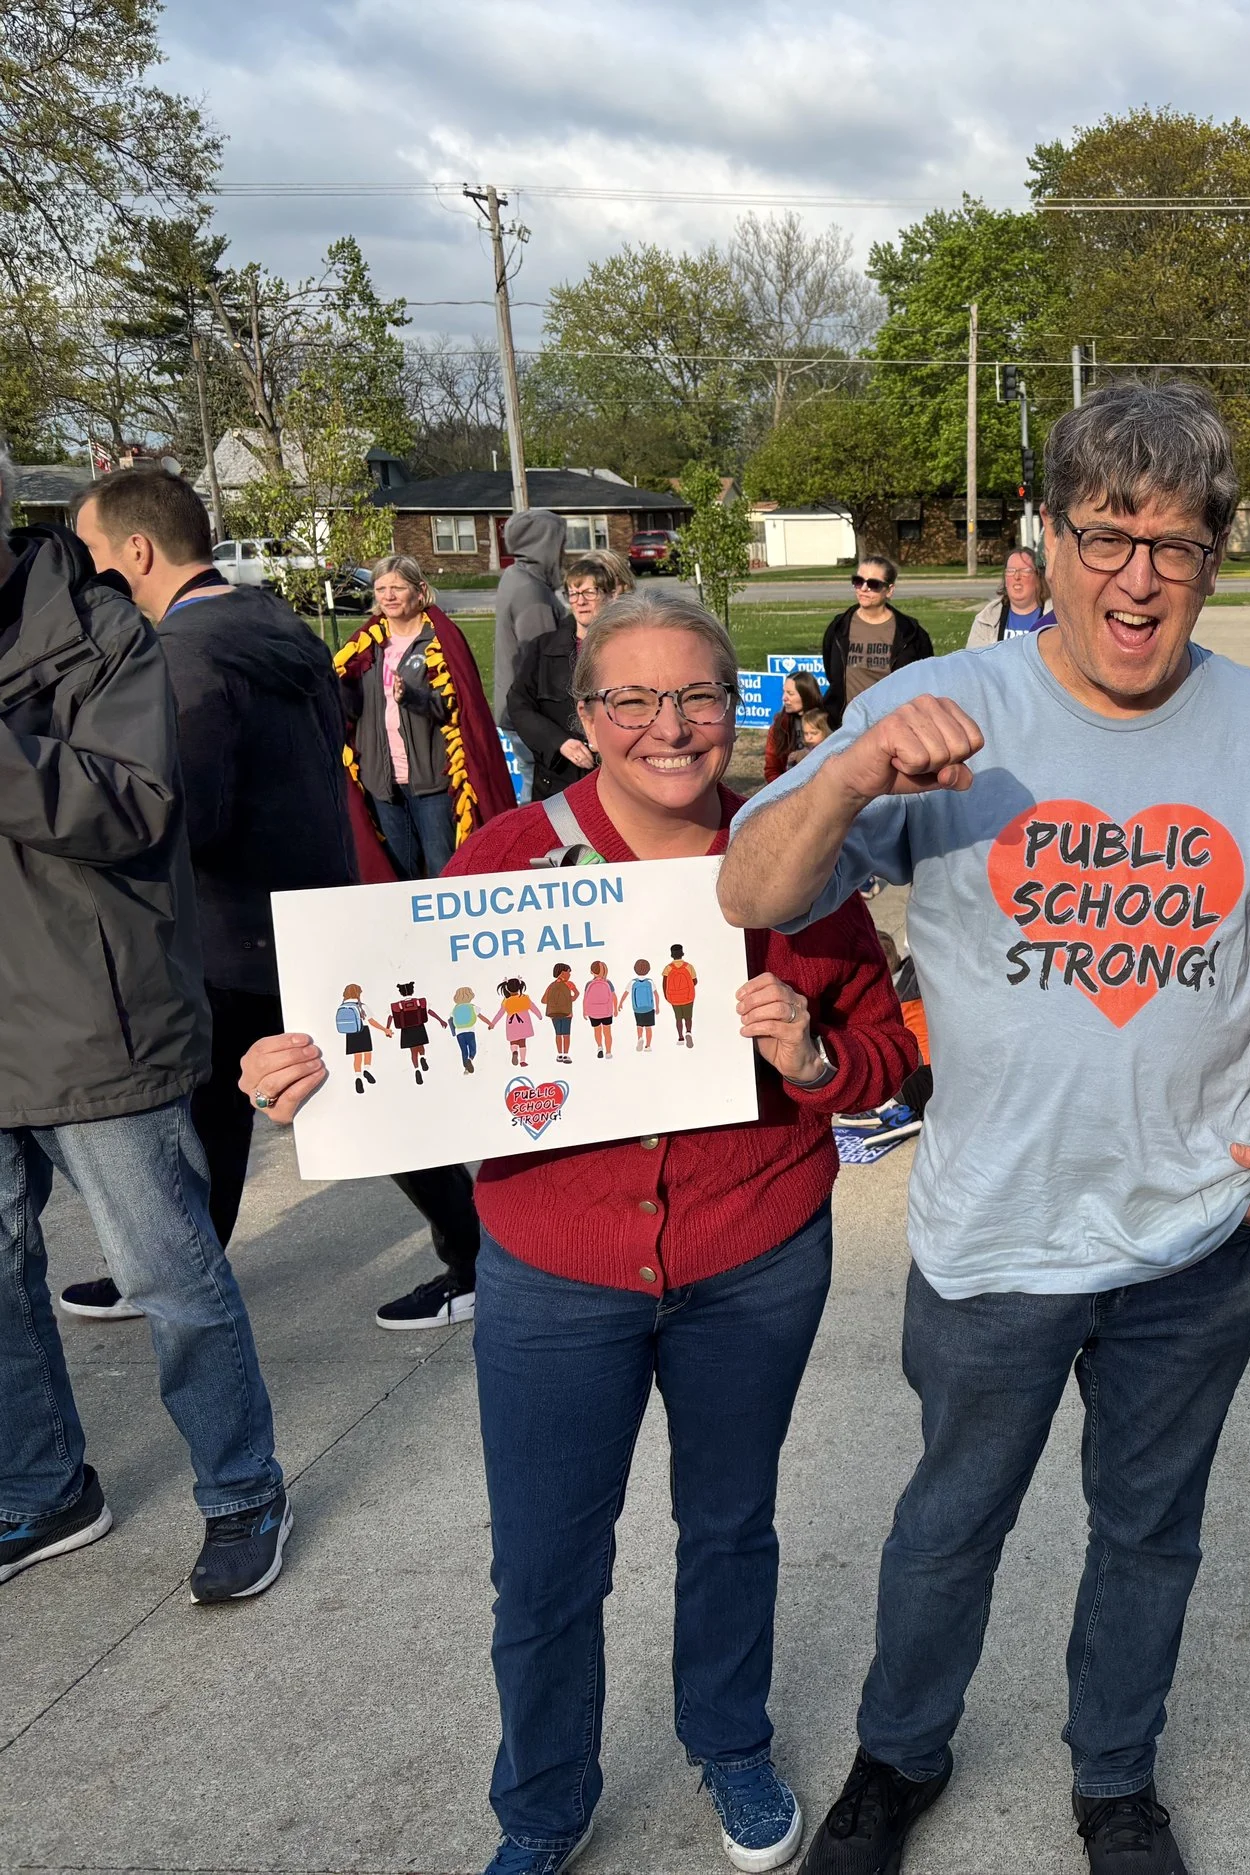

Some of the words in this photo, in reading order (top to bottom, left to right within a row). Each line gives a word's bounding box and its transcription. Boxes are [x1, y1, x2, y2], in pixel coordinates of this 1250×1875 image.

[774, 659, 781, 672] I
[1025, 821, 1211, 870] PUBLIC
[411, 876, 624, 923] EDUCATION
[1013, 881, 1221, 929] SCHOOL
[450, 928, 525, 962] FOR
[536, 921, 605, 953] ALL
[1006, 940, 1221, 993] STRONG!
[512, 1100, 559, 1115] SCHOOL
[514, 1086, 556, 1102] PUBLIC
[511, 1109, 562, 1127] STRONG!
